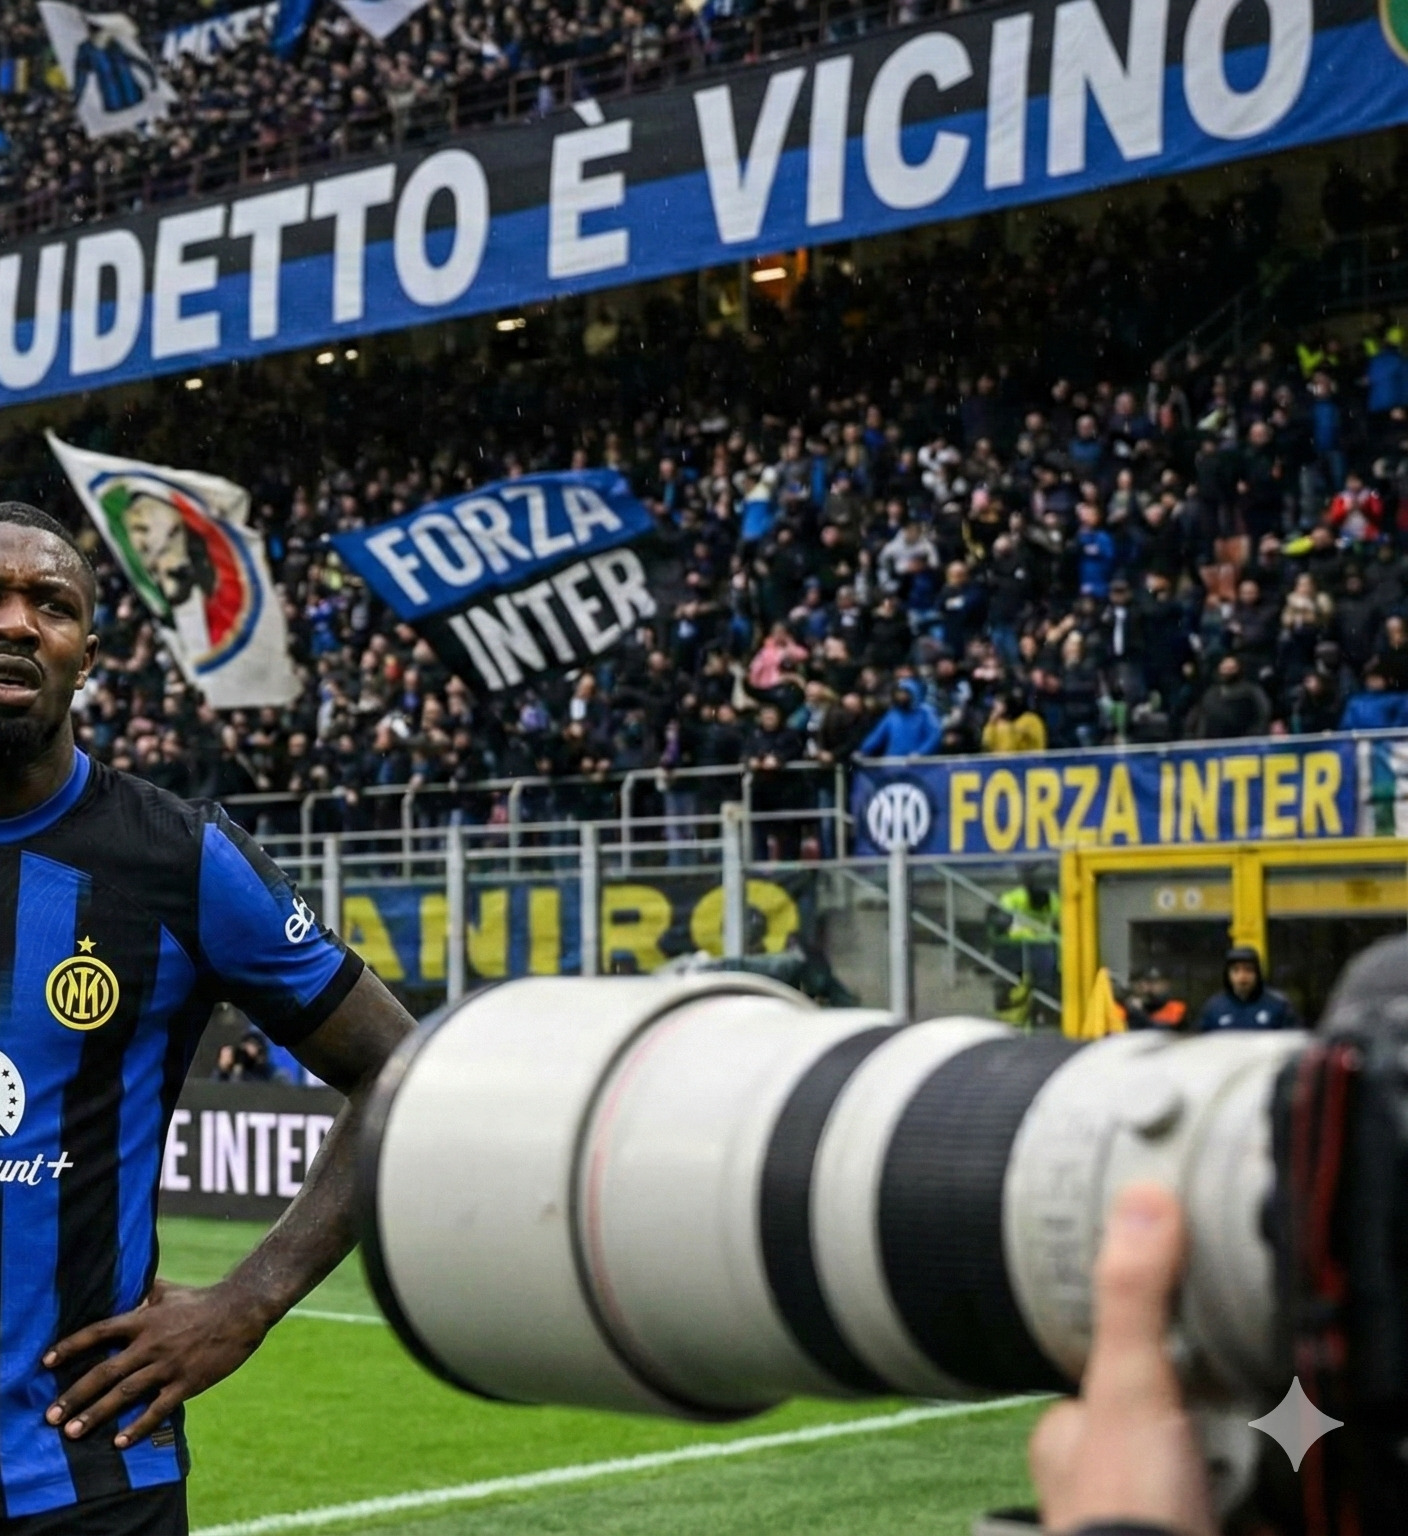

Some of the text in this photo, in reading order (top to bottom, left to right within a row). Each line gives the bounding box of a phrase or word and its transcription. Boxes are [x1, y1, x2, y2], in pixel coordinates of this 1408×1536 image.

[547, 99, 632, 280] È
[694, 0, 1314, 245] VICINO
[364, 485, 658, 691] FORZA INTER
[949, 763, 1141, 853] FORZA
[1159, 751, 1343, 844] INTER
